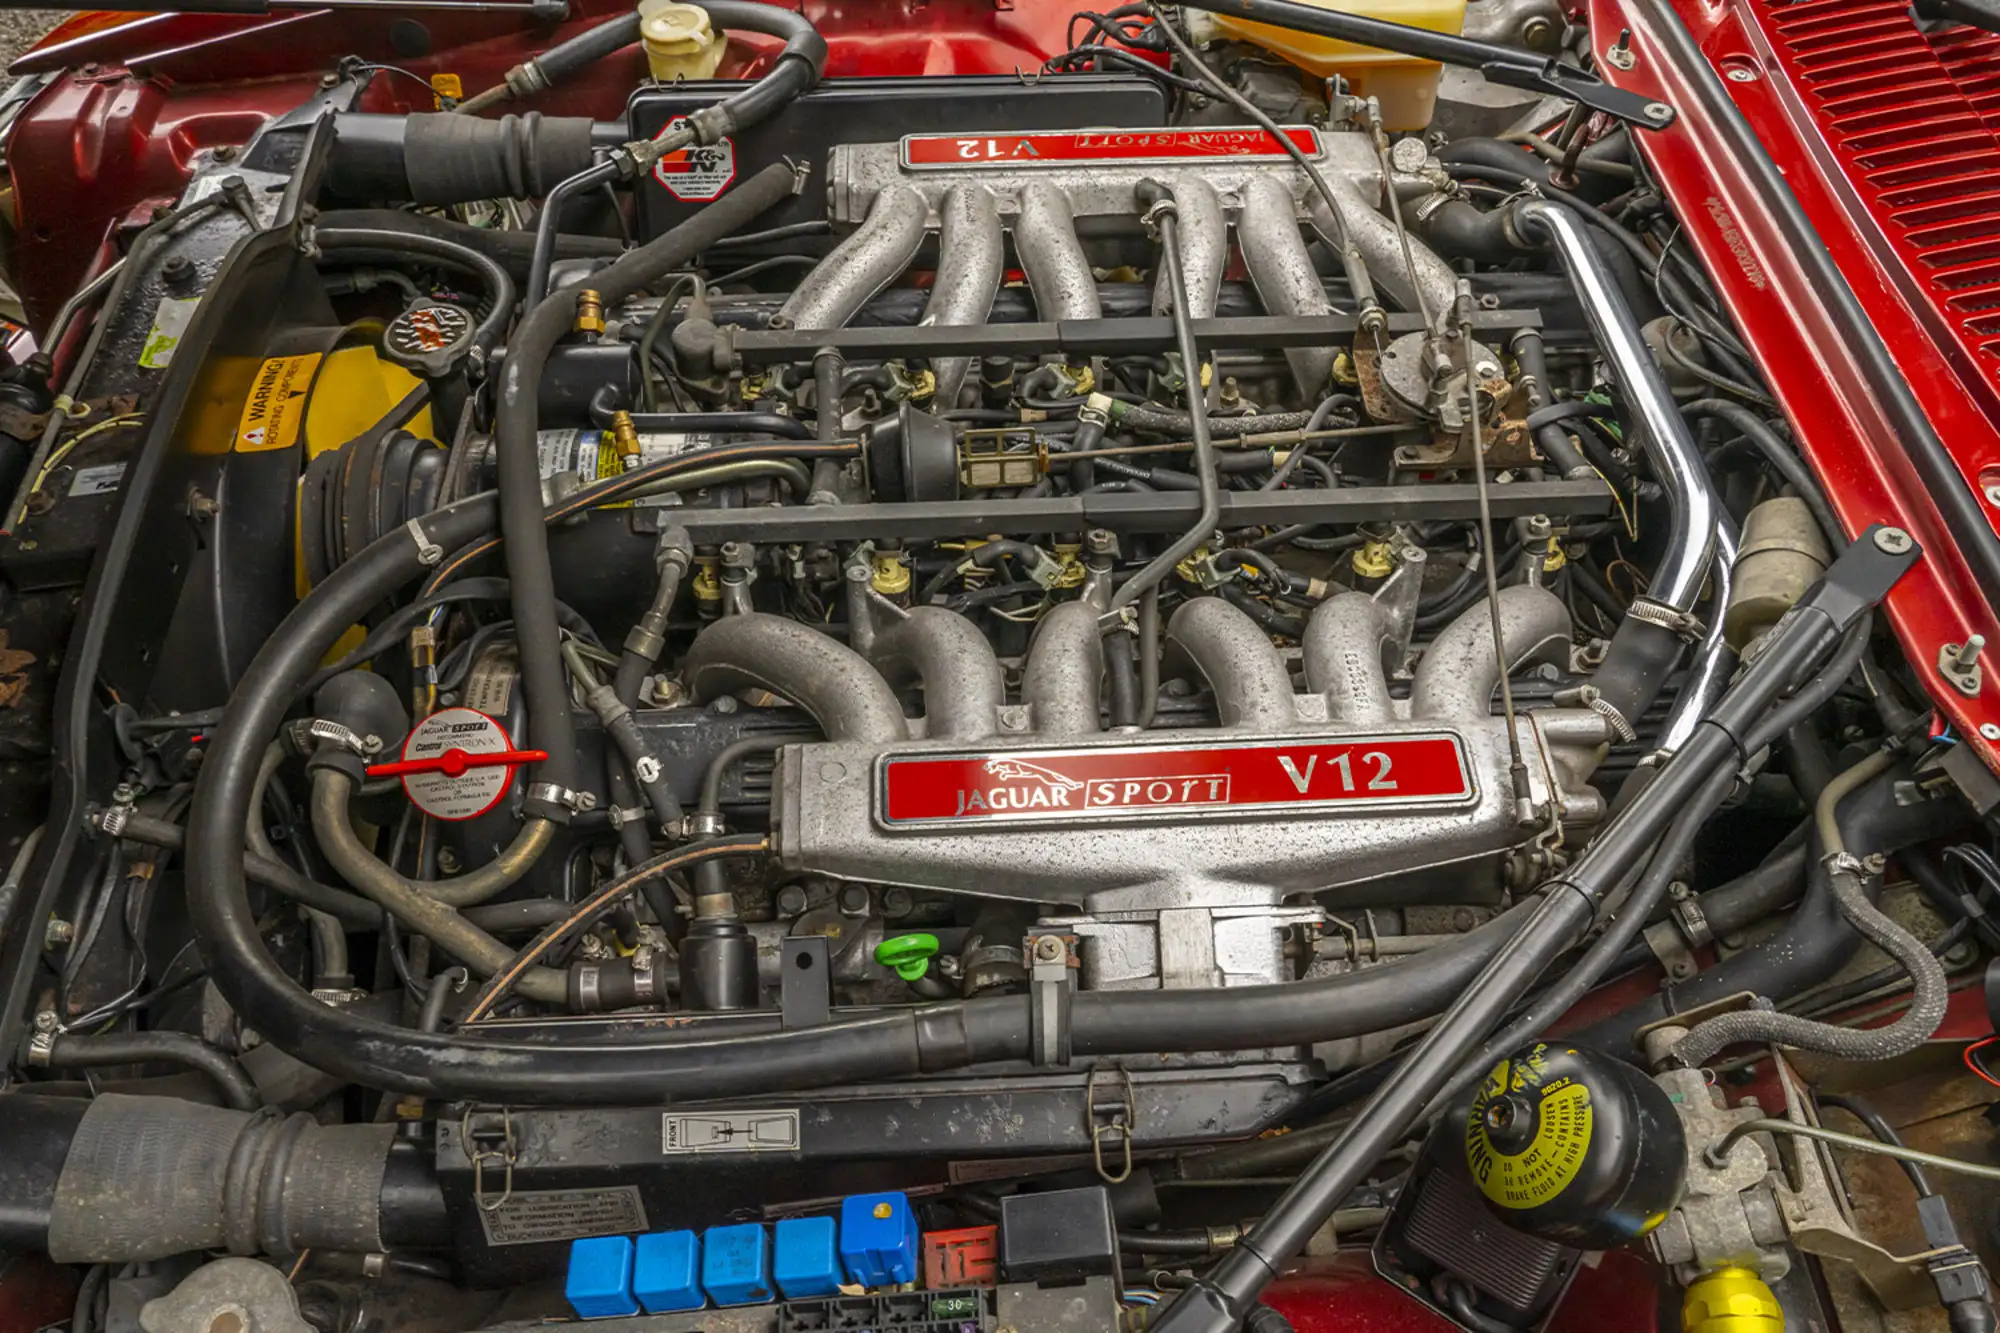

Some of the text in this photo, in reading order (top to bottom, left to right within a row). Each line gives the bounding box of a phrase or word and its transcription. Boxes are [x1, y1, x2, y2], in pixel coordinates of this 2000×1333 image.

[957, 139, 1040, 159] V12
[1188, 131, 1266, 144] JAGUAR
[420, 727, 449, 736] JAGUAR
[416, 742, 442, 752] Castrol
[955, 786, 1070, 817] JAGUAR
[1277, 751, 1398, 794] V12
[669, 1120, 677, 1147] FRONT
[1517, 1159, 1553, 1186] REMOVE
[1555, 1098, 1569, 1148] CONTAINS
[1523, 1148, 1543, 1169] NOT
[1544, 1103, 1556, 1139] LOOSEN
[1554, 1165, 1567, 1180] AT
[1564, 1142, 1580, 1165] HIGH
[948, 1299, 962, 1311] 30
